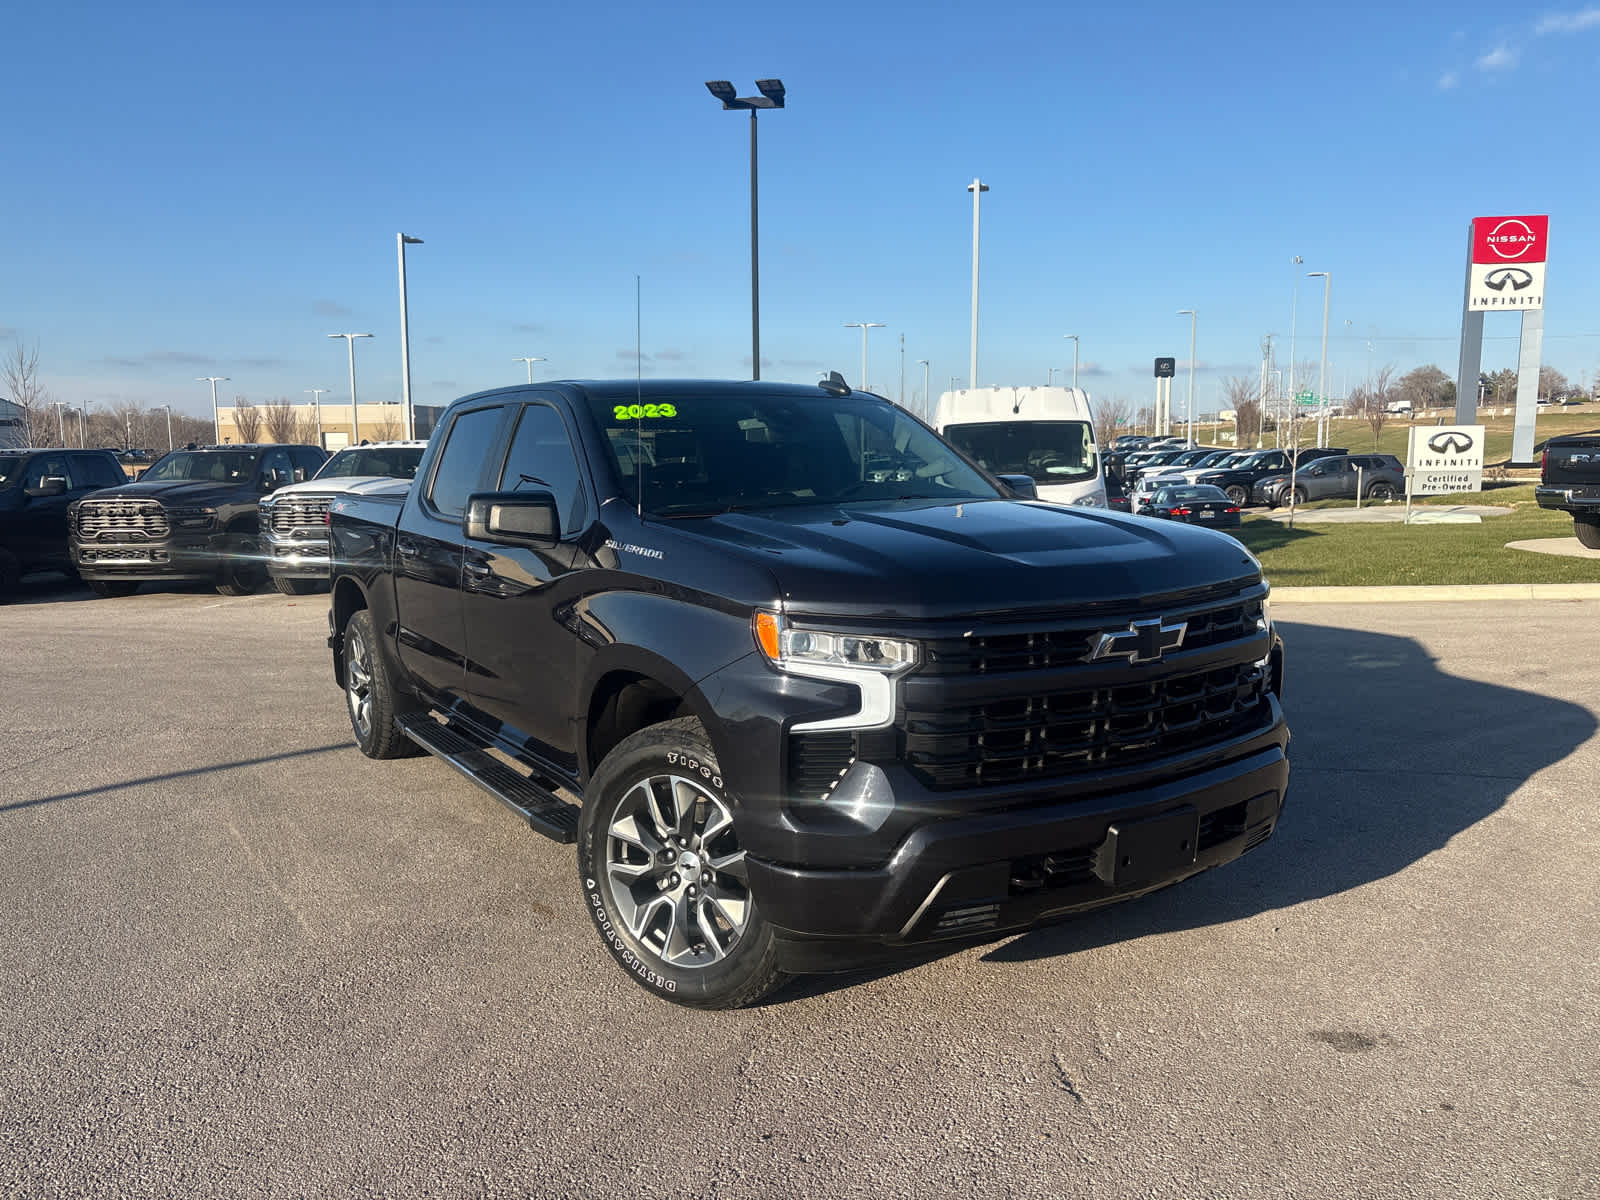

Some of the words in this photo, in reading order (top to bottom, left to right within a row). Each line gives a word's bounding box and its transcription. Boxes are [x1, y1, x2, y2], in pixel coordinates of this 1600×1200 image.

[1487, 235, 1536, 243] NISSAN
[1473, 296, 1541, 305] INFINITI
[613, 403, 677, 420] 2023
[1427, 474, 1468, 483] Certified
[1422, 483, 1473, 491] Pre-Owned
[604, 539, 665, 560] SILVERADO
[591, 893, 677, 992] DESTINATION
